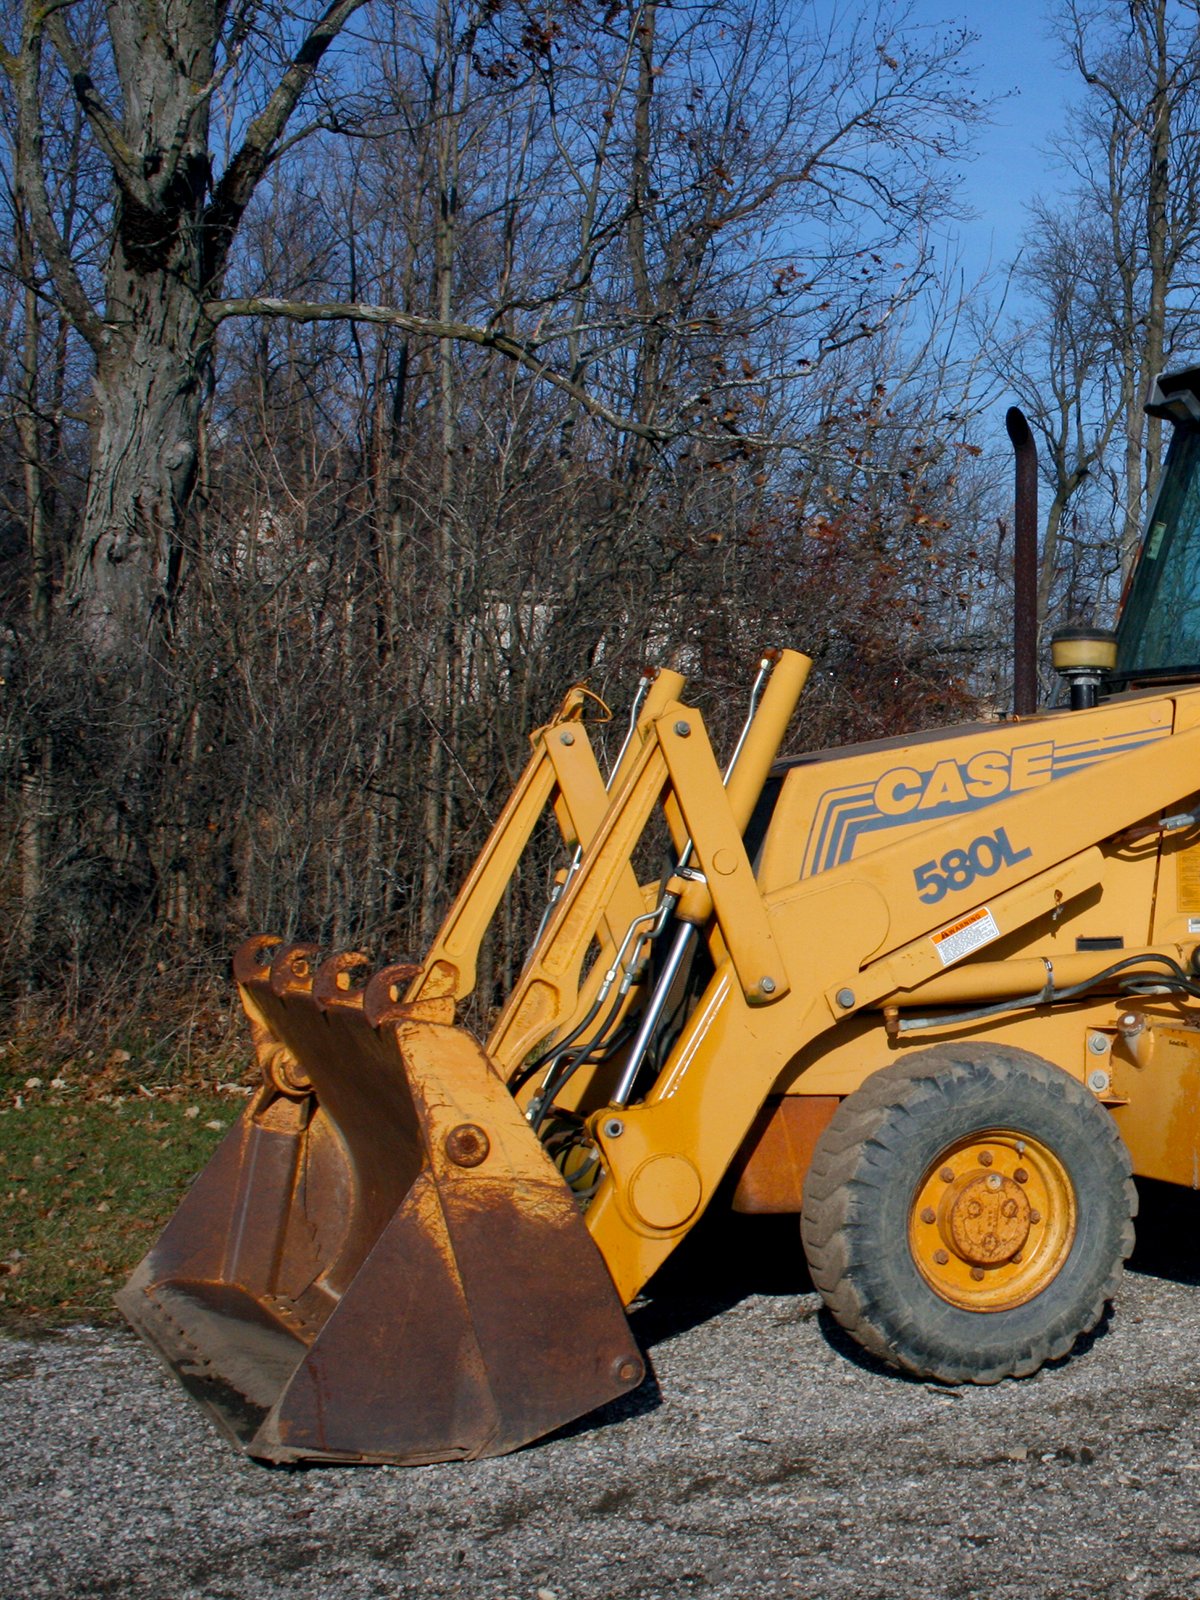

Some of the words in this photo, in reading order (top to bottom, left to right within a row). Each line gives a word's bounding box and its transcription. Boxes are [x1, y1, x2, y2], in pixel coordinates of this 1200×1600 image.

[872, 741, 1054, 815] CASE
[912, 827, 1032, 904] 580L
[949, 914, 981, 936] WARNING
